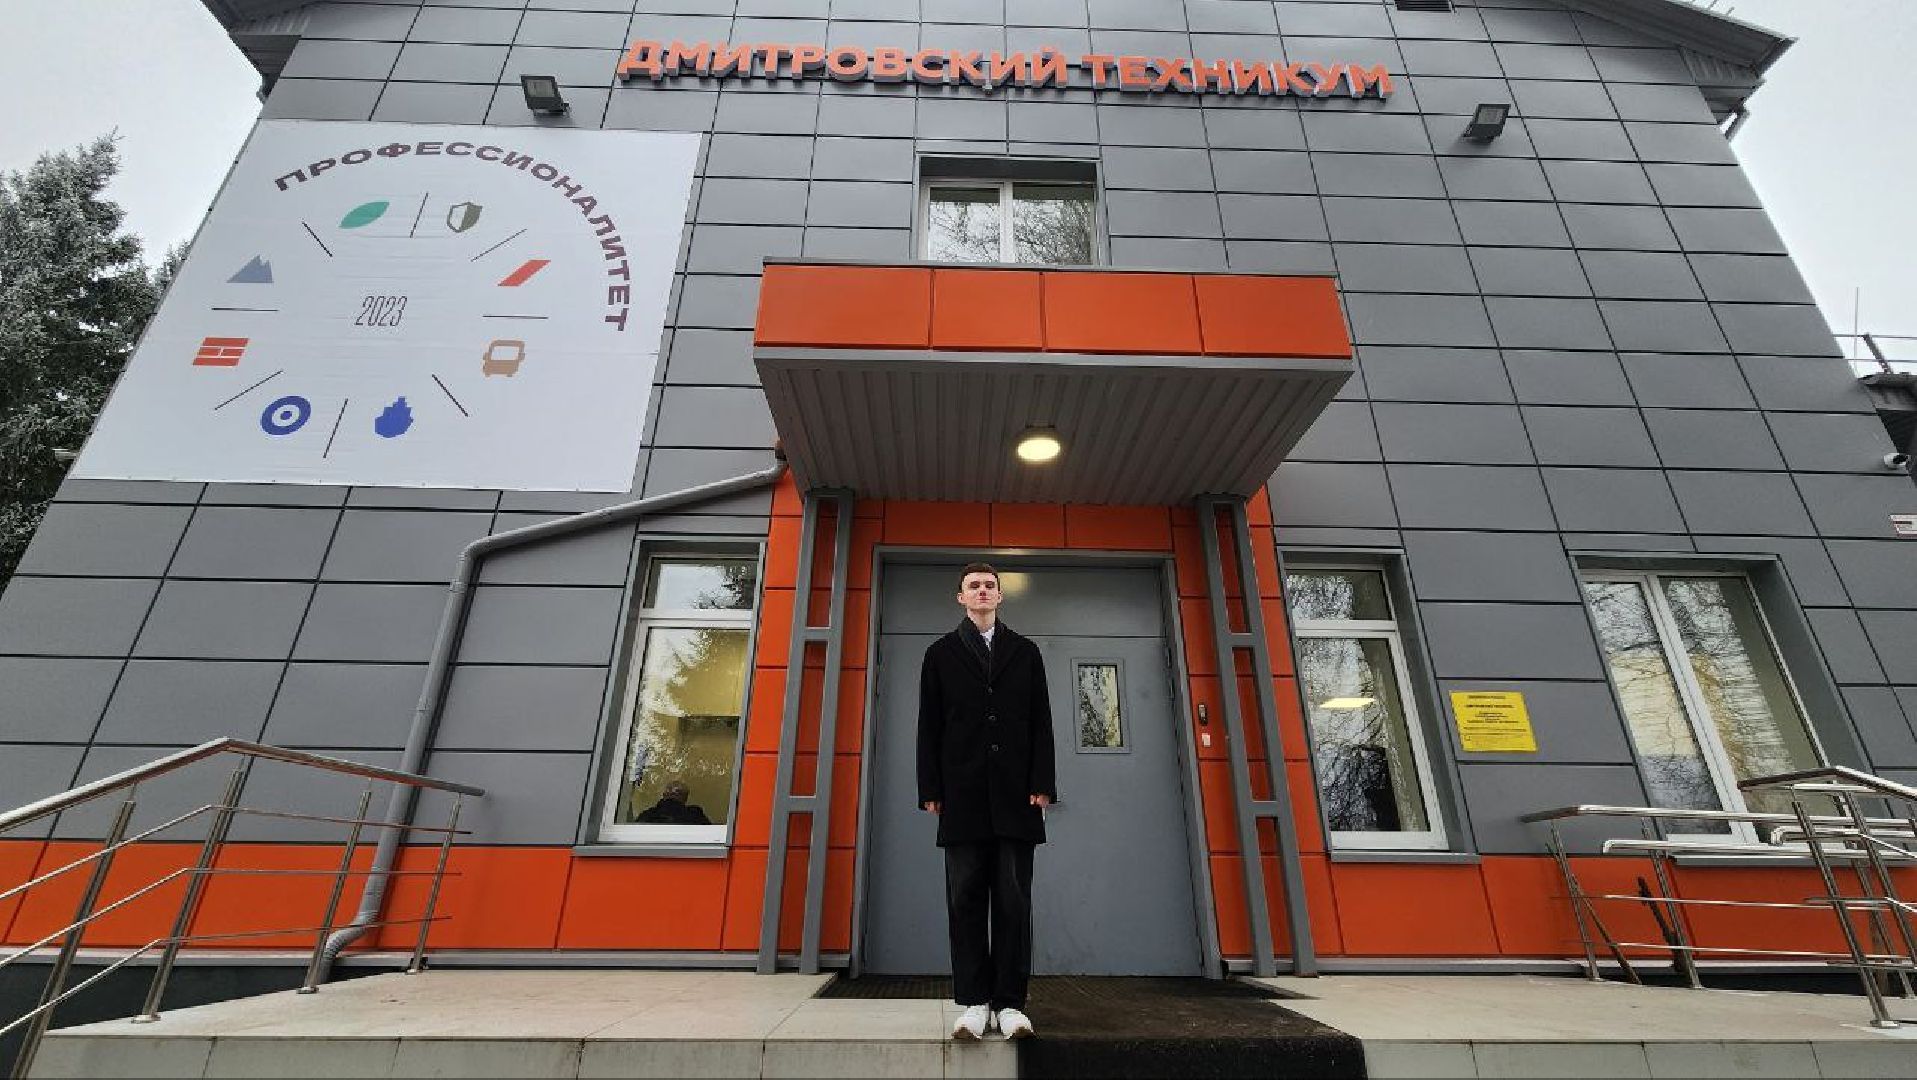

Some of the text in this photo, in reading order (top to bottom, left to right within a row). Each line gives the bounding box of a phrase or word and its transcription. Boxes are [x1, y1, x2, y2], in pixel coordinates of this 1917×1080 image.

[617, 40, 1394, 98] ДМИТРОВСКИЙ ТЕХНИКУМ
[275, 141, 630, 331] ПРОФЕССИОНАЛИТЕТ
[354, 296, 407, 327] 2023
